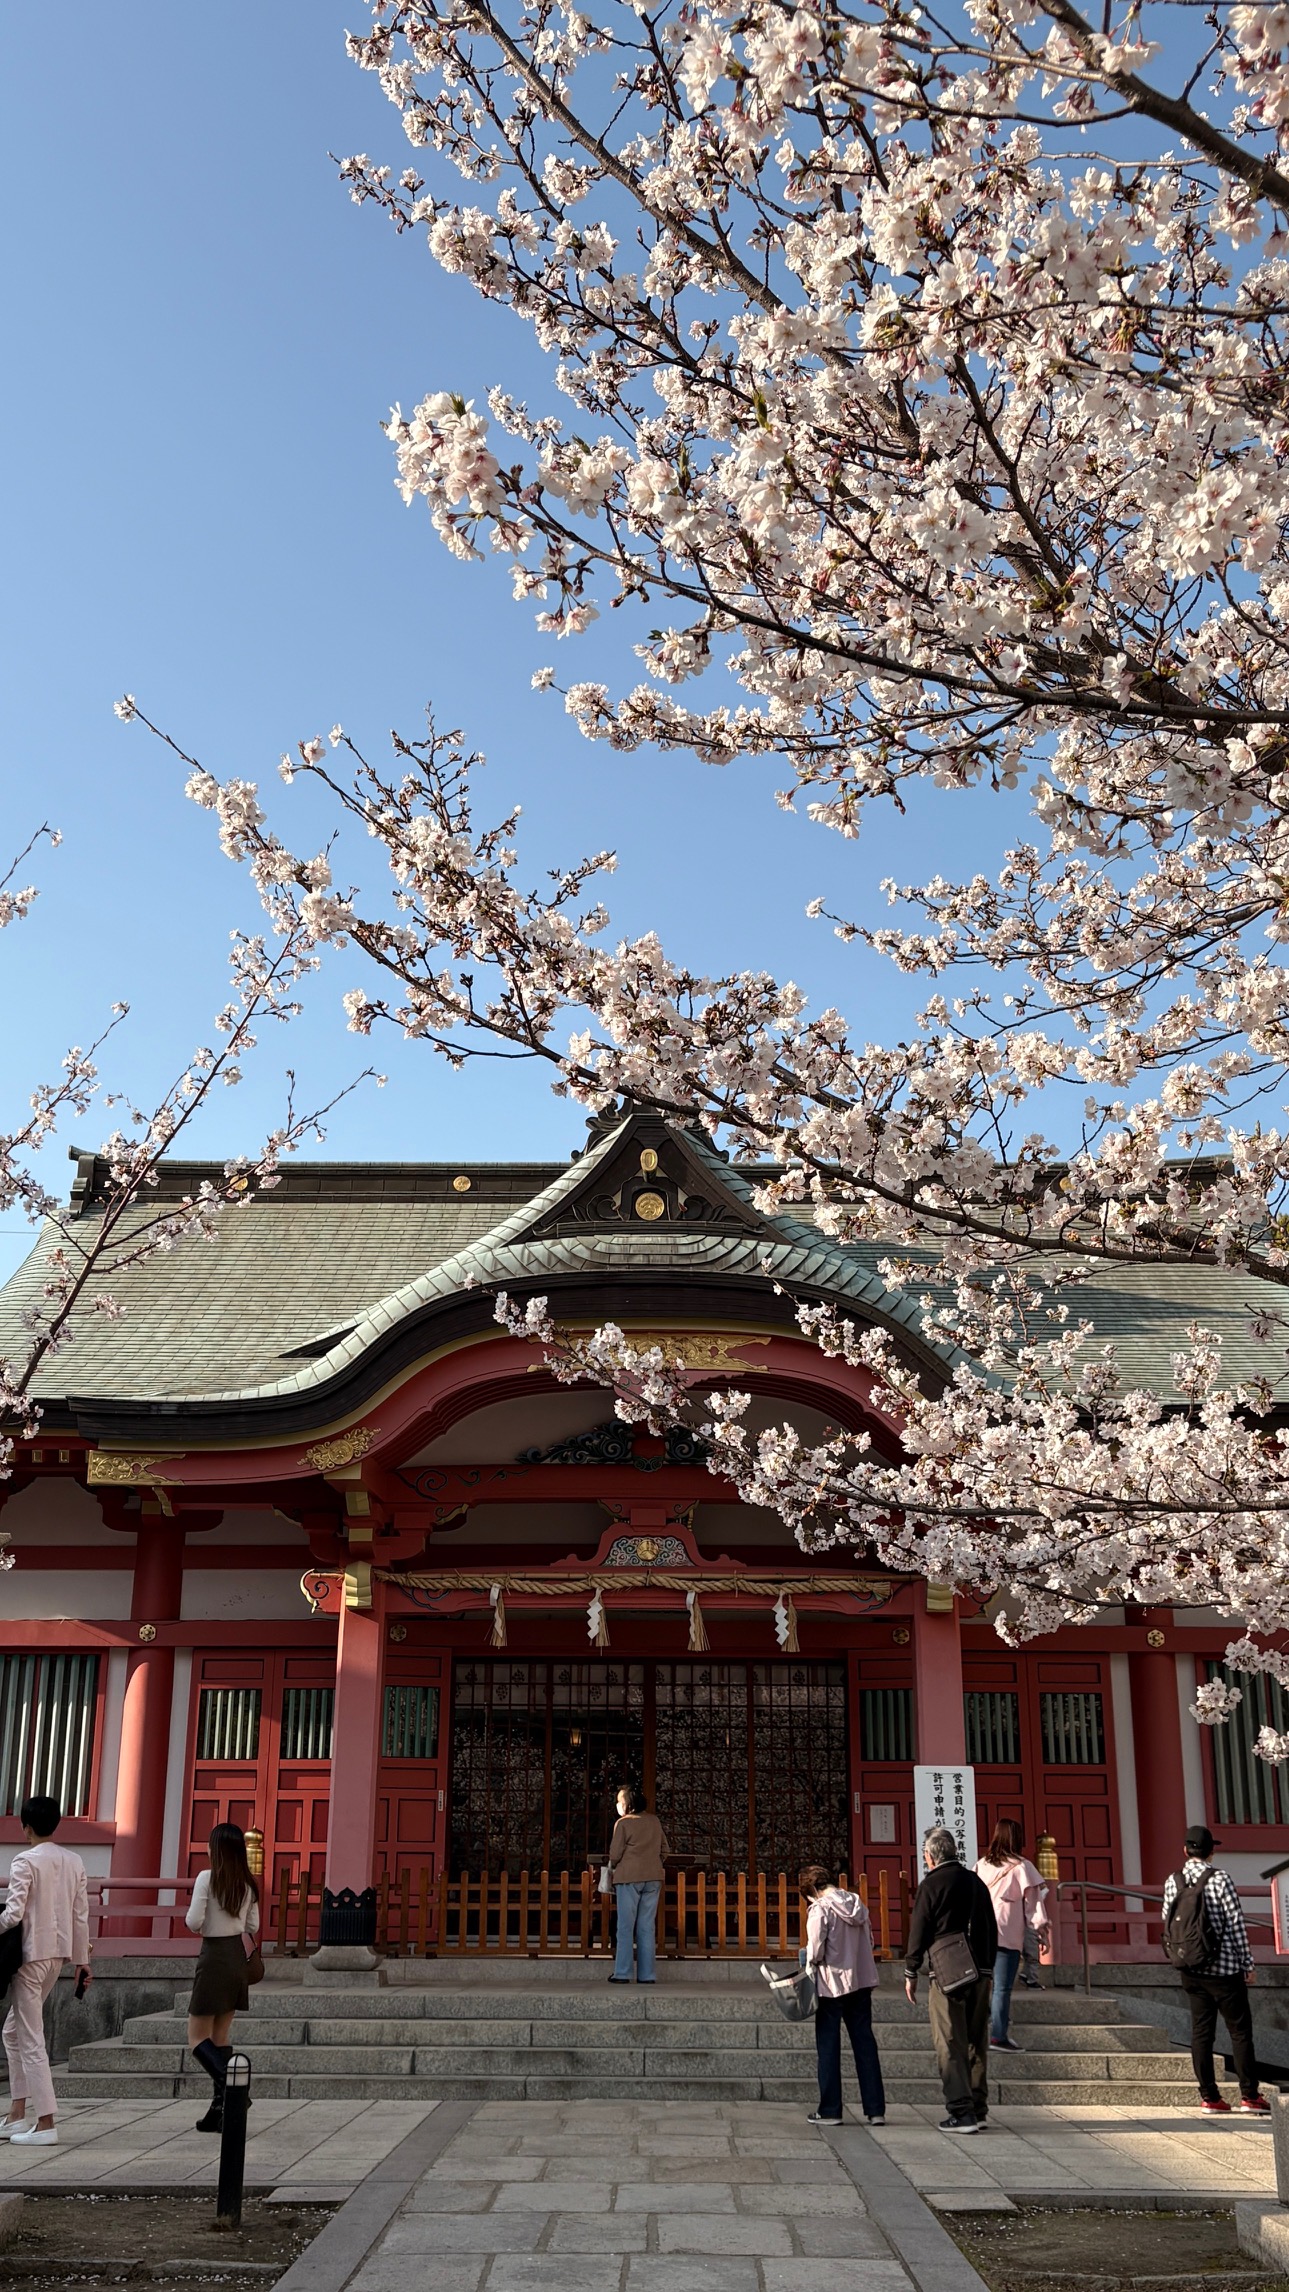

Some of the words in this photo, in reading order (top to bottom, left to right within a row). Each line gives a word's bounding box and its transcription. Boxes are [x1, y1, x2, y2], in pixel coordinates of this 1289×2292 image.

[952, 1773, 967, 1868] 営業目的の写真撮
